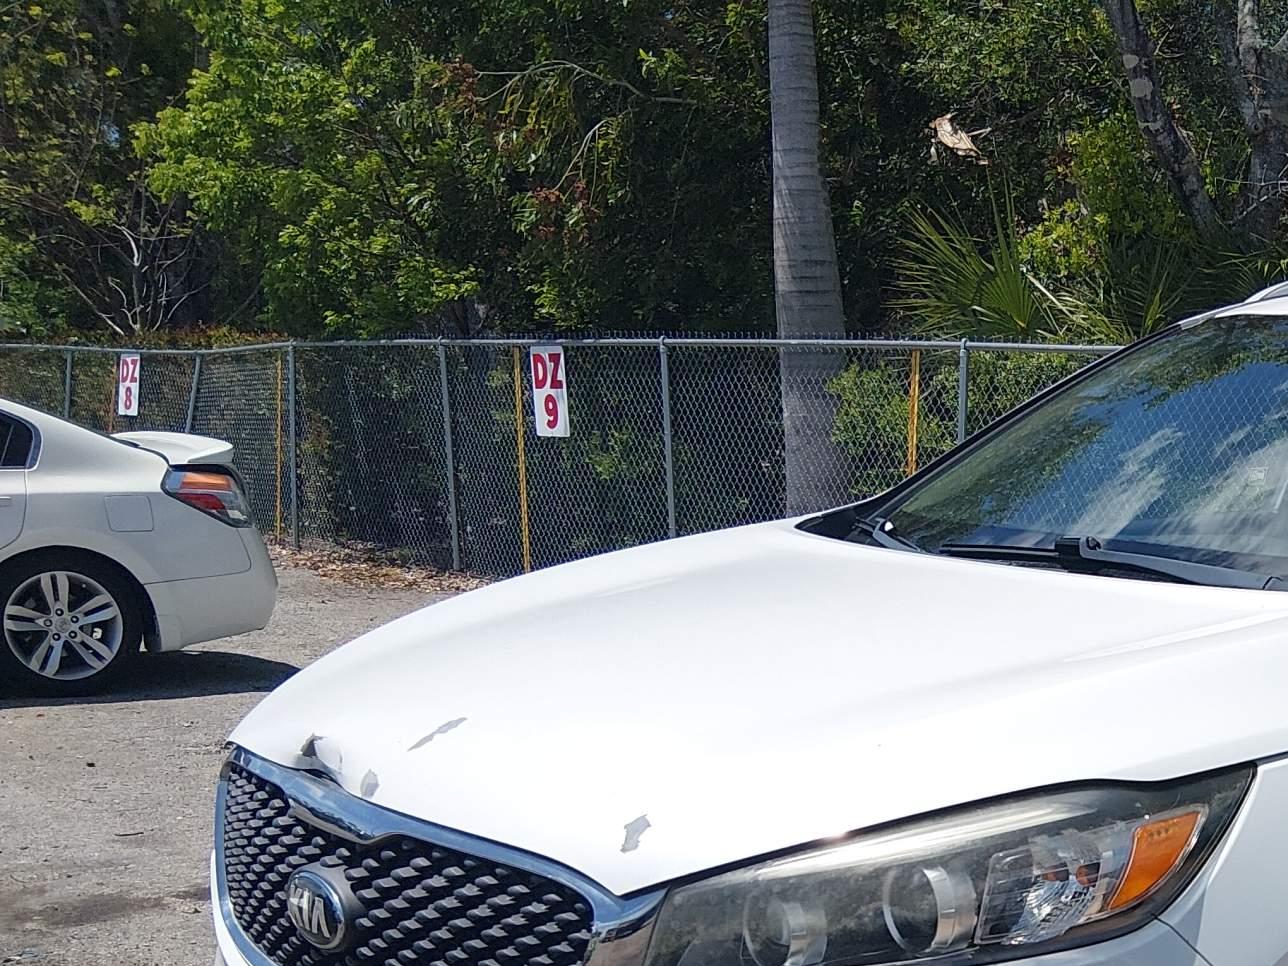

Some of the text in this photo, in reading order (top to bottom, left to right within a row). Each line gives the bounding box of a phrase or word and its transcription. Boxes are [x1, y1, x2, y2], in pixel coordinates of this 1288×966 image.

[120, 359, 138, 383] DZ
[533, 353, 563, 389] DZ
[124, 386, 133, 411] 8
[544, 394, 560, 430] 9
[289, 884, 331, 939] KIA
